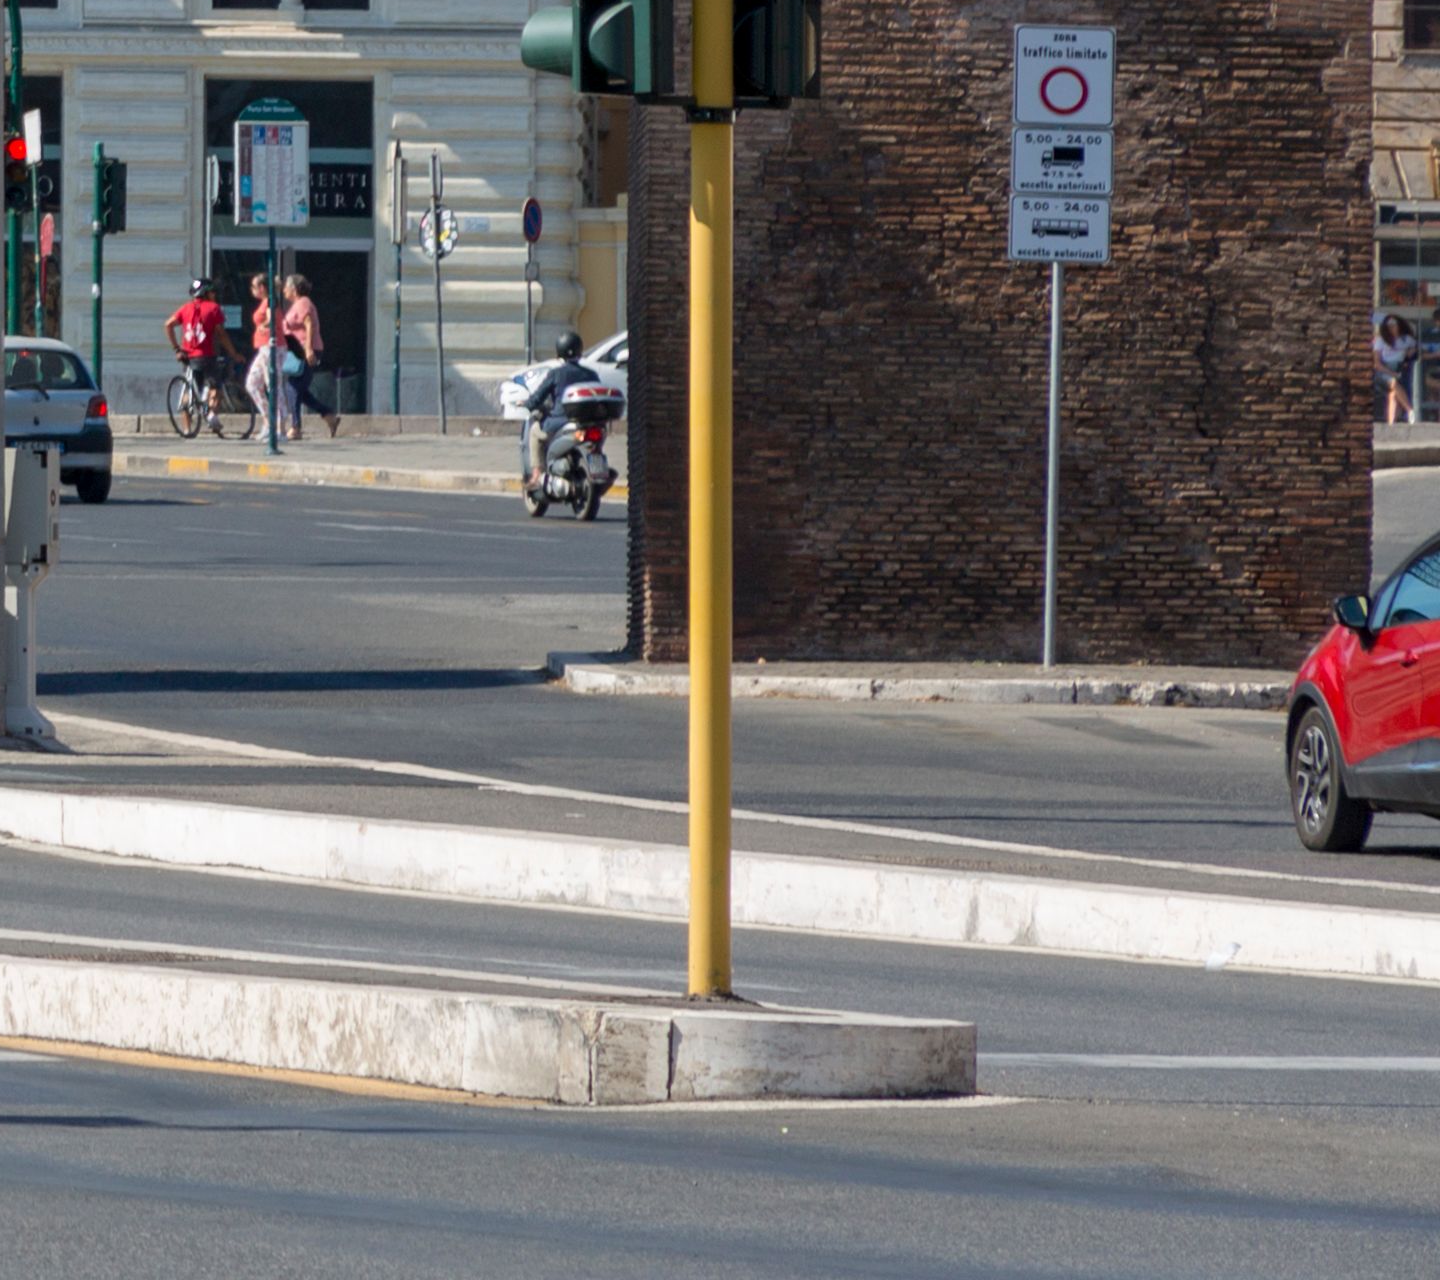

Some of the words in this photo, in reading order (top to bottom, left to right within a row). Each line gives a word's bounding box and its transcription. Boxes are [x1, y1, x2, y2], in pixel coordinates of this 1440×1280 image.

[1053, 33, 1077, 43] zona
[1023, 46, 1064, 59] traffico
[1066, 47, 1108, 60] limitato
